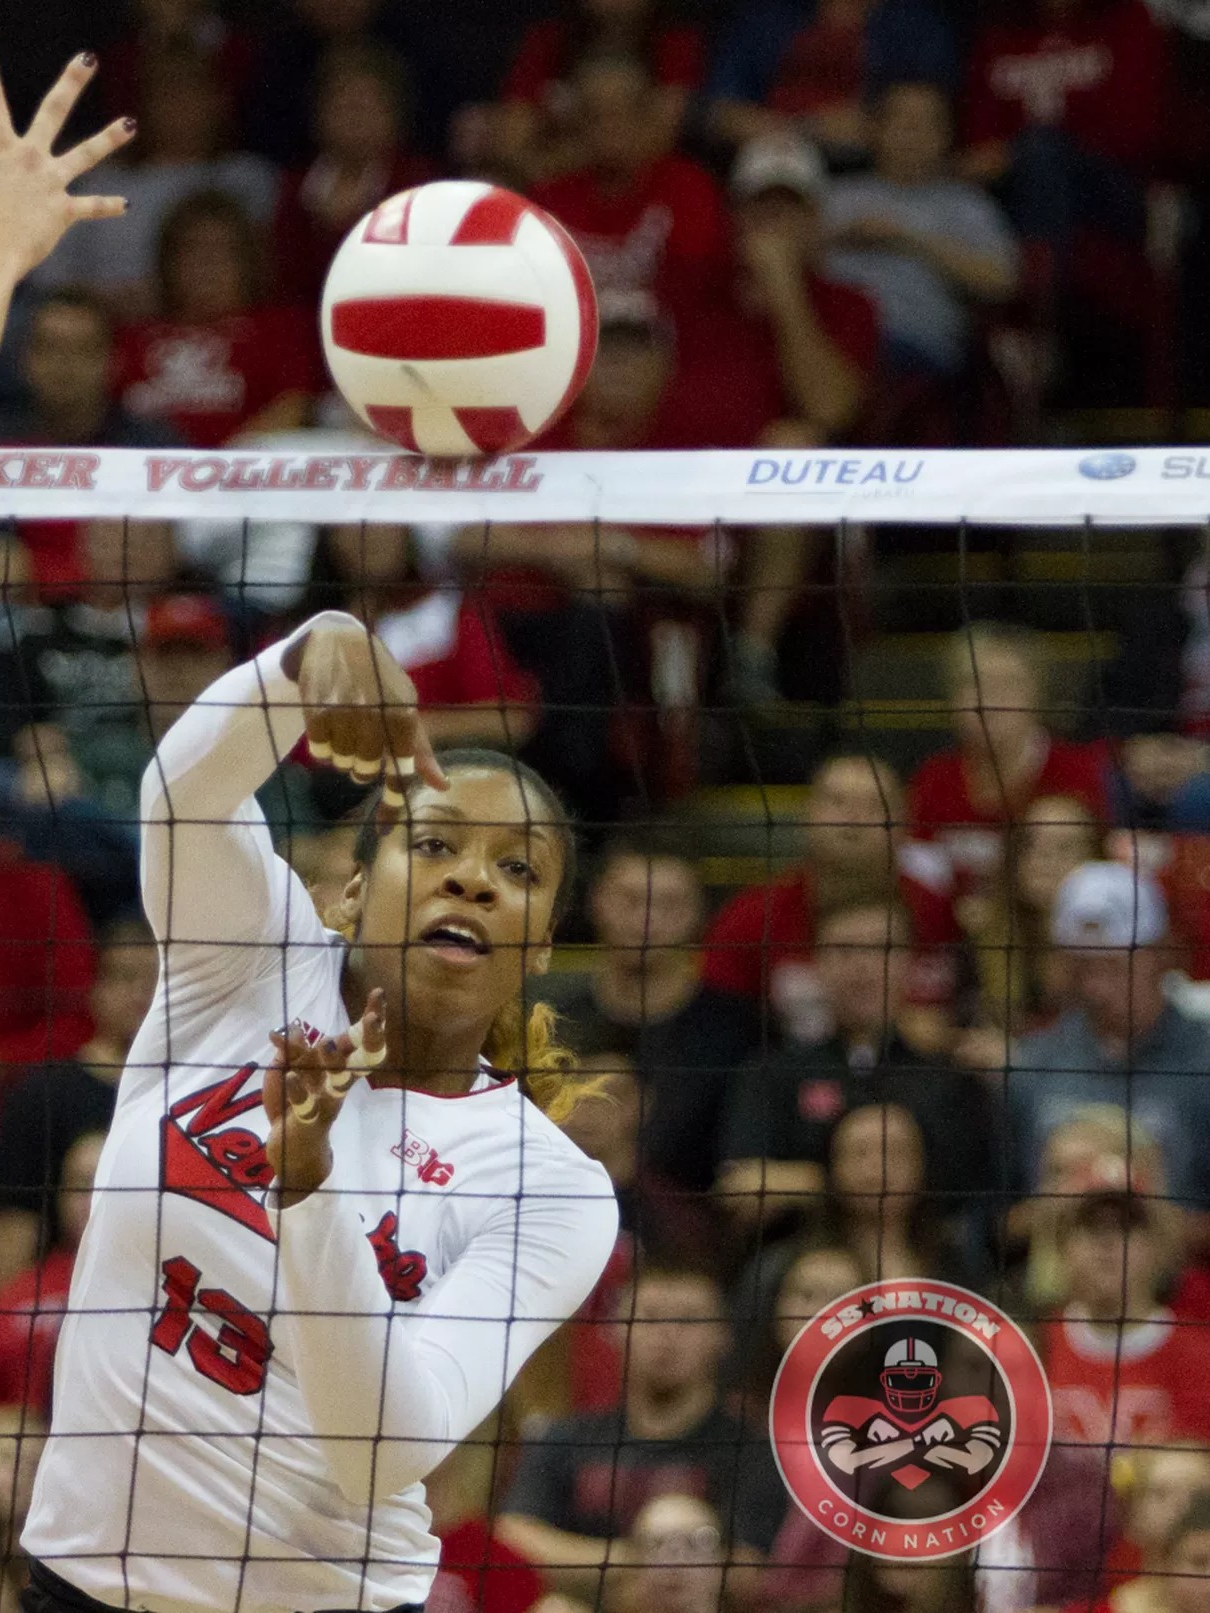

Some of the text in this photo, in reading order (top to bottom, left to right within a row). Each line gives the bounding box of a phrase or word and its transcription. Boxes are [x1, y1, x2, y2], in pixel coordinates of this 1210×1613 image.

[144, 455, 544, 493] VOLLEYBALL
[747, 459, 924, 485] DUTEAU
[148, 1254, 275, 1396] 13
